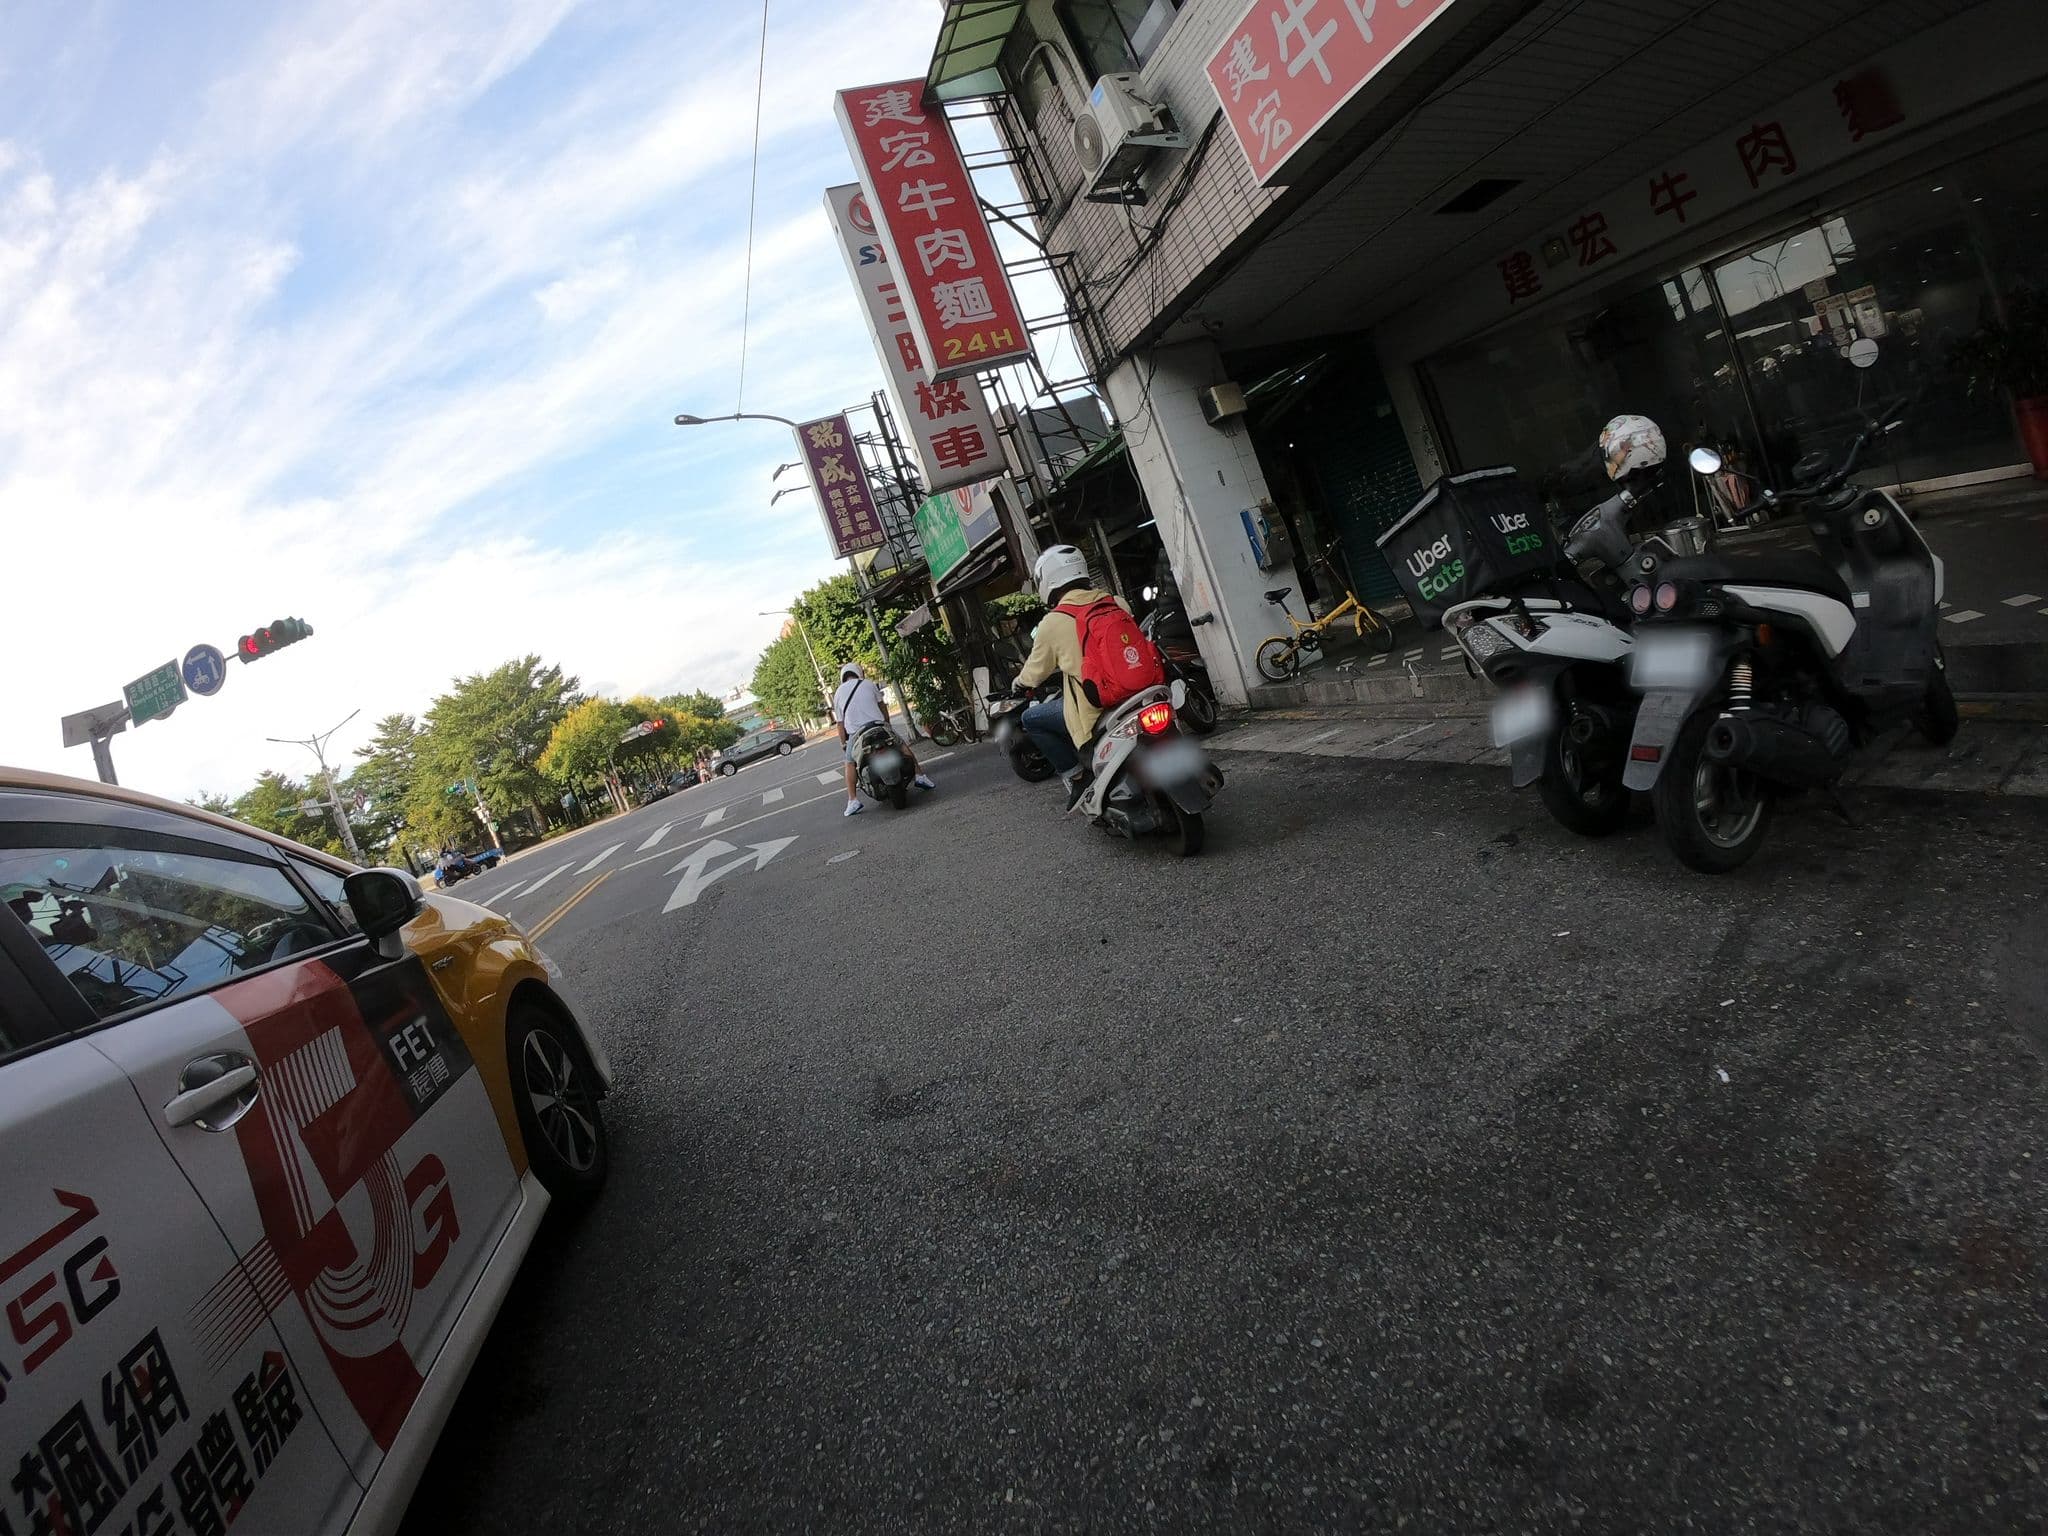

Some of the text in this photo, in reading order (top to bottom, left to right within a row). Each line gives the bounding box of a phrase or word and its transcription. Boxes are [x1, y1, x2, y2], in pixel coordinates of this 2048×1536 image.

[1222, 33, 1293, 164] 建宏
[861, 88, 998, 330] 建宏牛肉麵
[944, 328, 1014, 360] 24H
[807, 421, 857, 486] 瑞成
[1490, 512, 1530, 535] Uber
[1506, 533, 1543, 556] Eats
[1406, 533, 1453, 578] Uber
[1417, 558, 1466, 601] Eats
[389, 1017, 436, 1071] FET
[408, 1052, 450, 1104] 遠傳
[0, 1327, 190, 1536] 飆網
